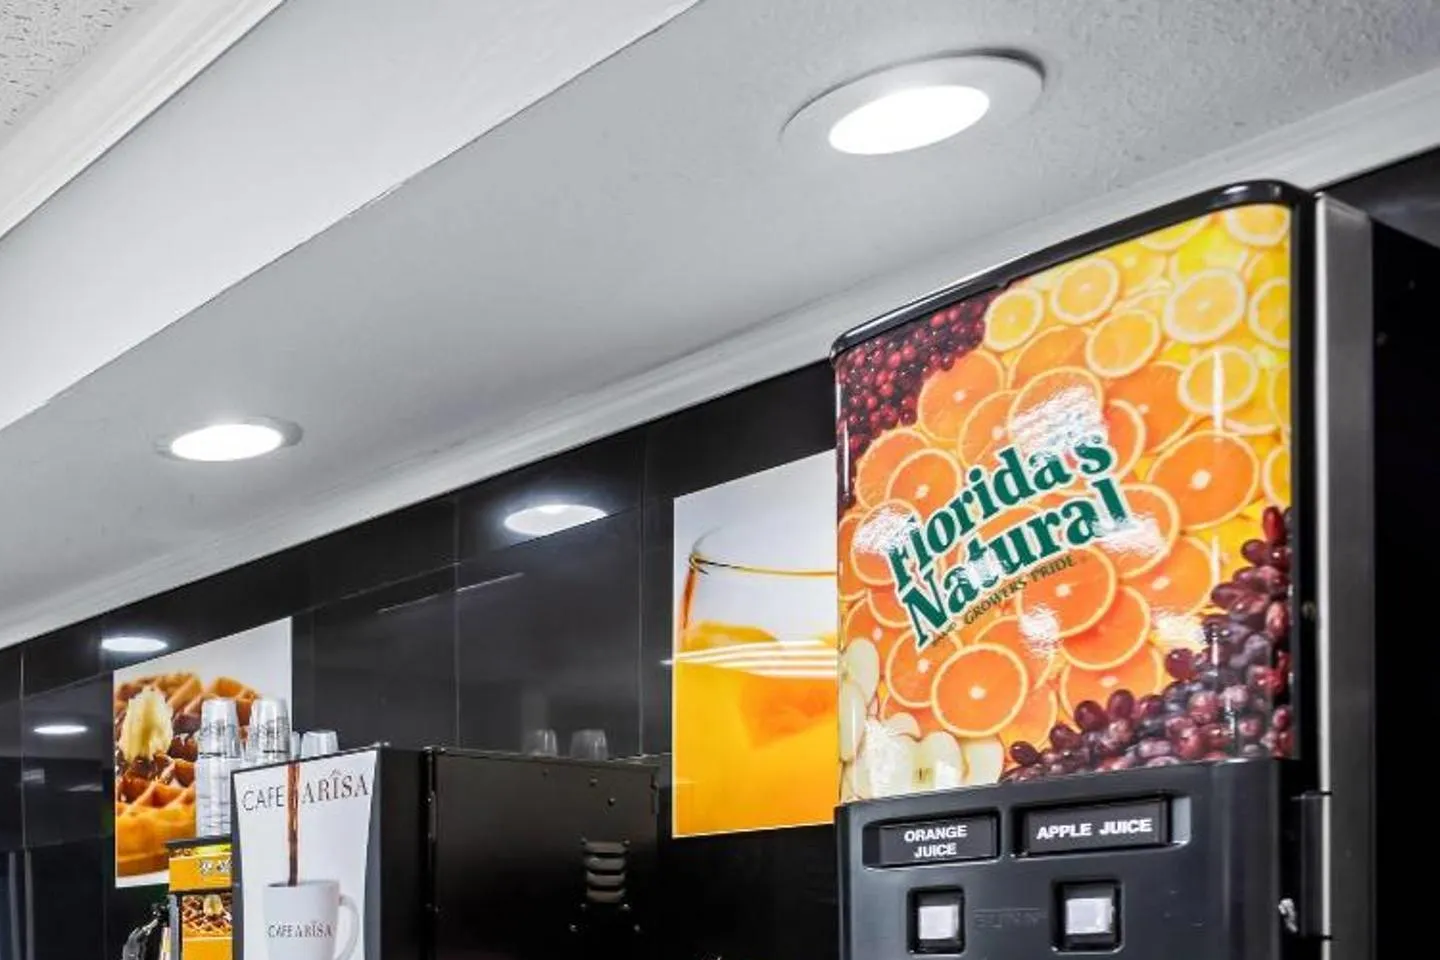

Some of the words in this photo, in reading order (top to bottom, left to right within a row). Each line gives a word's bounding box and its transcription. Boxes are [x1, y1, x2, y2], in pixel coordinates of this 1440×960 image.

[903, 478, 1127, 648] Natural
[964, 577, 1026, 625] GROWERS
[904, 825, 968, 843] ORANGE
[1036, 821, 1092, 840] APPLE
[1100, 818, 1153, 836] JUICE
[914, 843, 957, 858] JUICE
